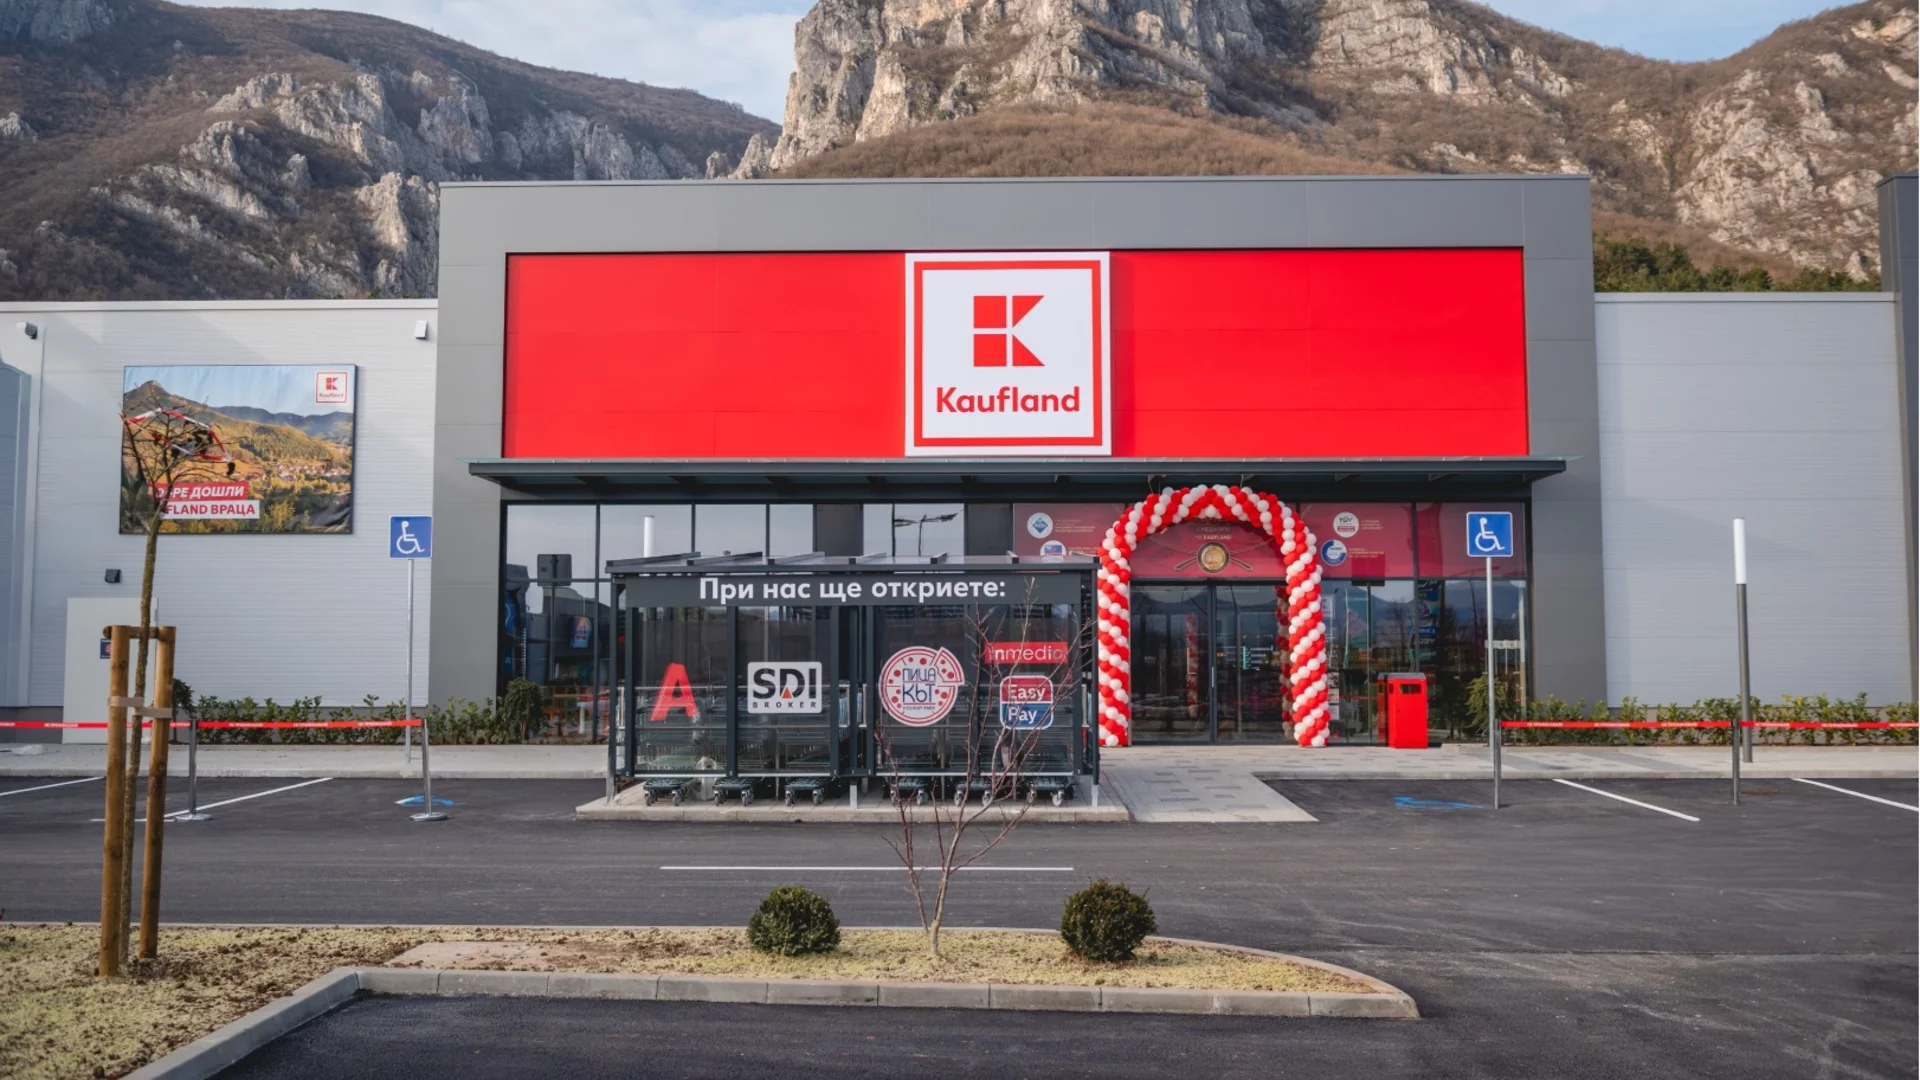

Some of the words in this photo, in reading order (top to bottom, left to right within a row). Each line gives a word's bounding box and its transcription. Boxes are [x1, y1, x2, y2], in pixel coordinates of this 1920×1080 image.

[936, 386, 1080, 413] Kaufland
[190, 486, 245, 499] ДОШЛИ
[211, 504, 255, 516] ВРАЦА
[700, 577, 754, 605] При
[763, 582, 811, 599] нас
[819, 582, 862, 602] ще
[871, 580, 1006, 603] откриете:
[902, 667, 936, 682] ПИЦА
[753, 668, 817, 699] SDI
[1009, 684, 1046, 701] Easy
[752, 701, 817, 709] BROKER
[1008, 706, 1037, 724] Pay
